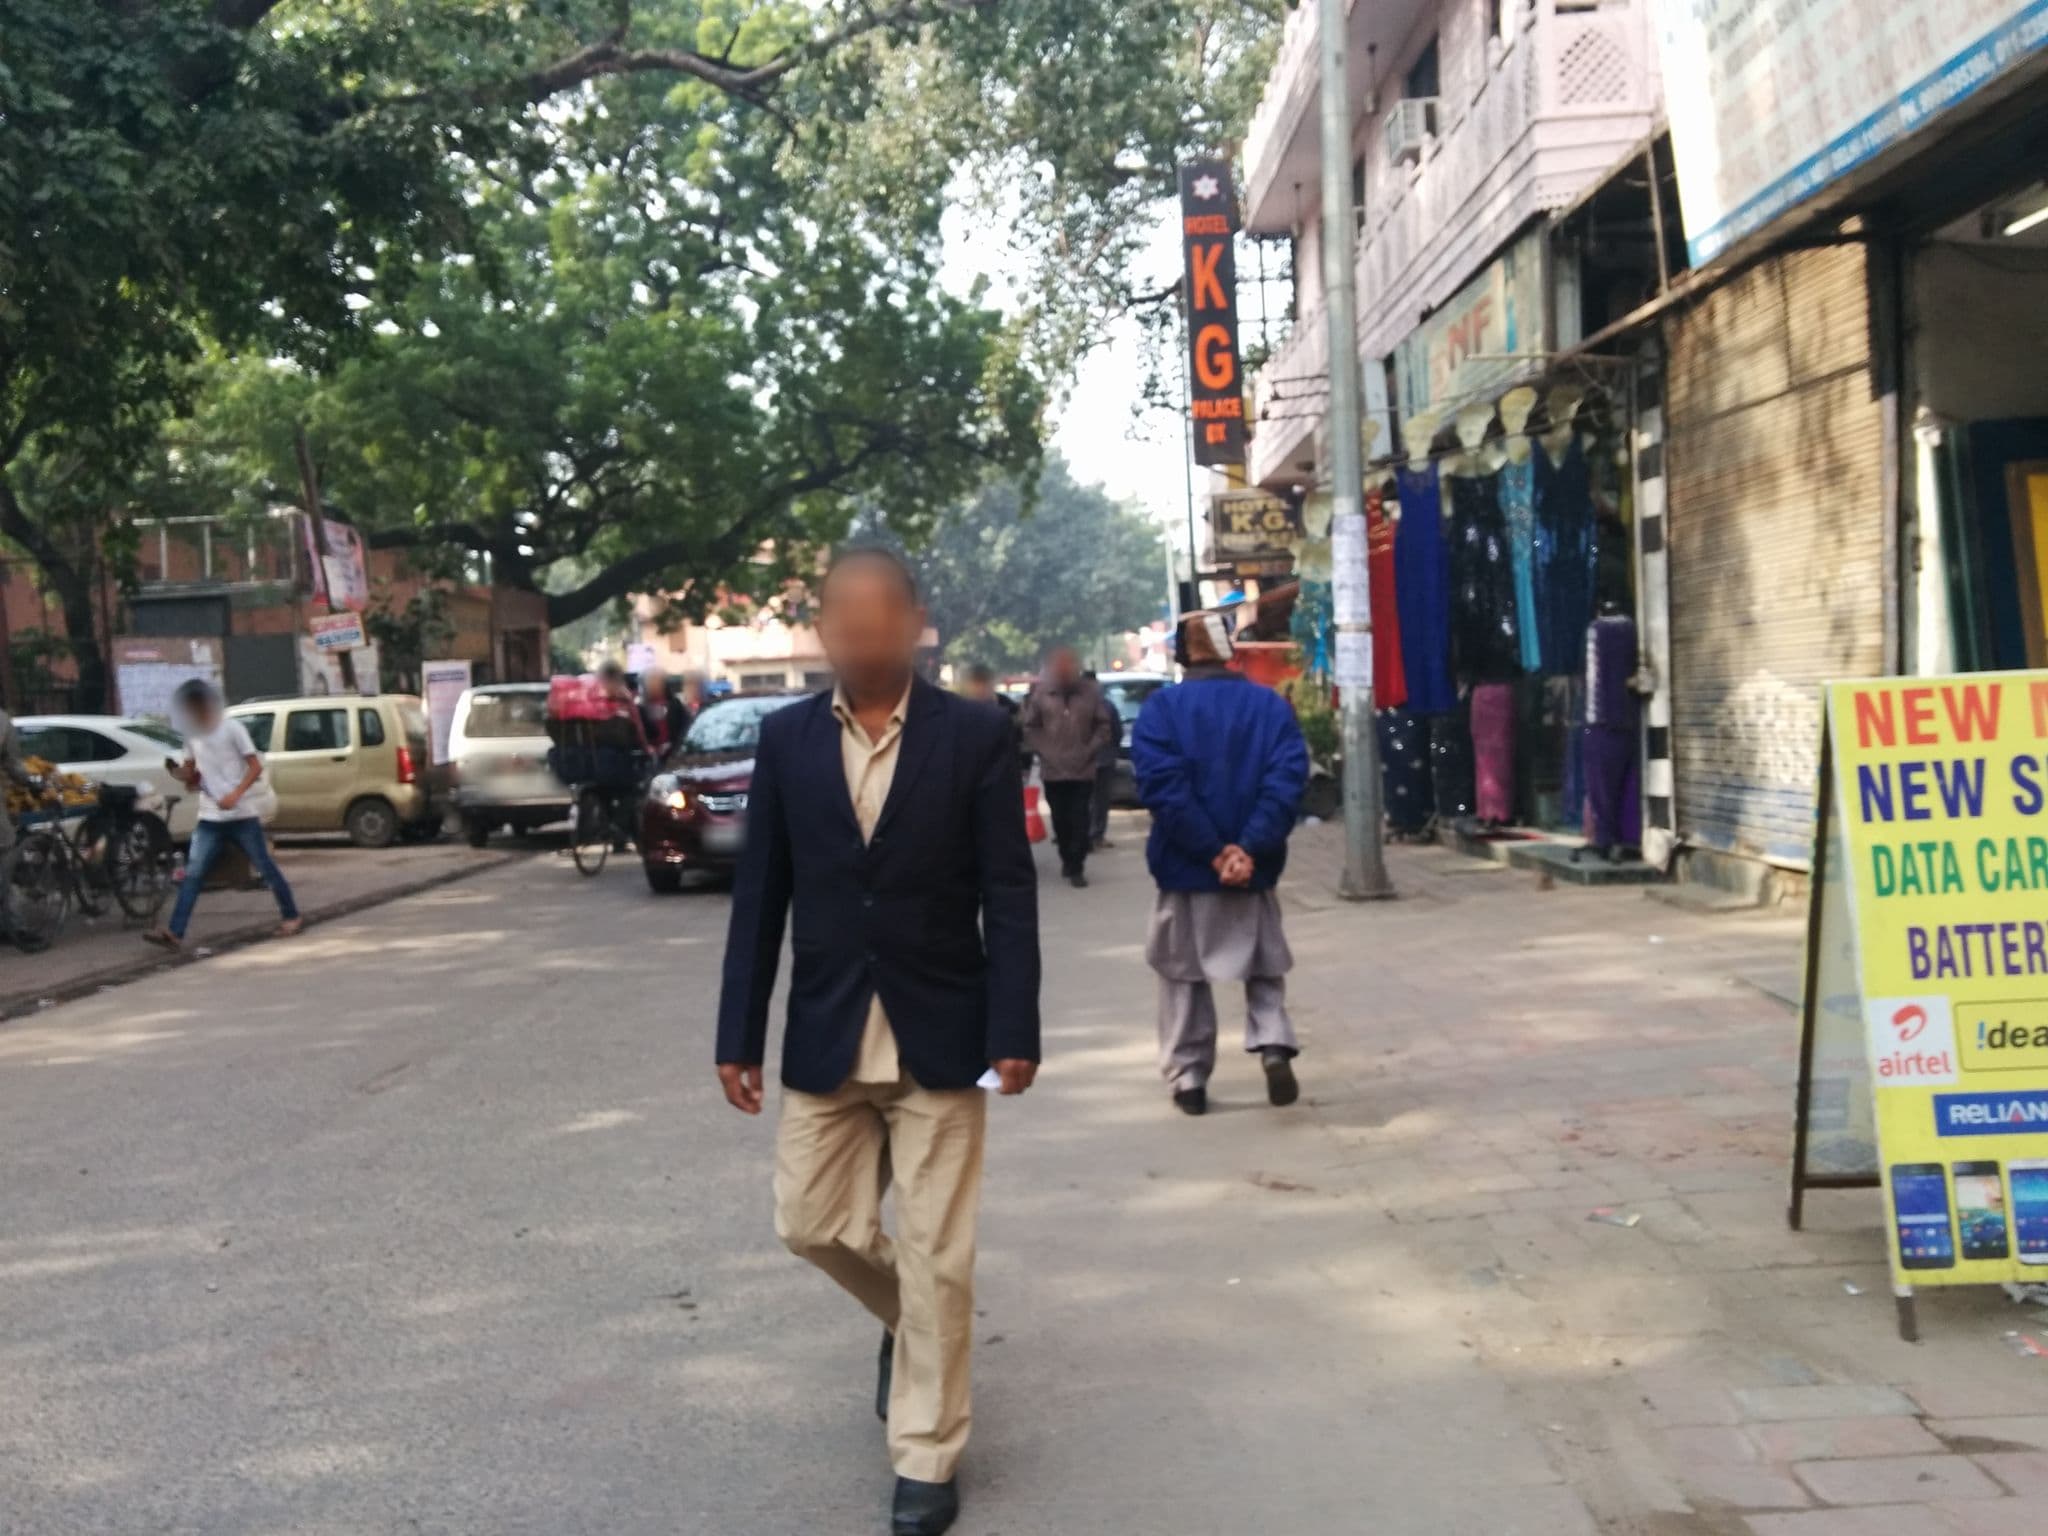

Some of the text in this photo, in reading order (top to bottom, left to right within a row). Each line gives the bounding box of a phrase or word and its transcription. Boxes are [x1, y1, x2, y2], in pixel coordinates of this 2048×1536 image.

[1191, 243, 1228, 310] K
[1195, 323, 1234, 390] G
[1854, 683, 2002, 748] NEW
[1857, 754, 2048, 823] NEW S
[1872, 841, 1965, 897] DATA
[1907, 921, 2048, 980] BATTER
[1879, 1051, 1952, 1077] airtel
